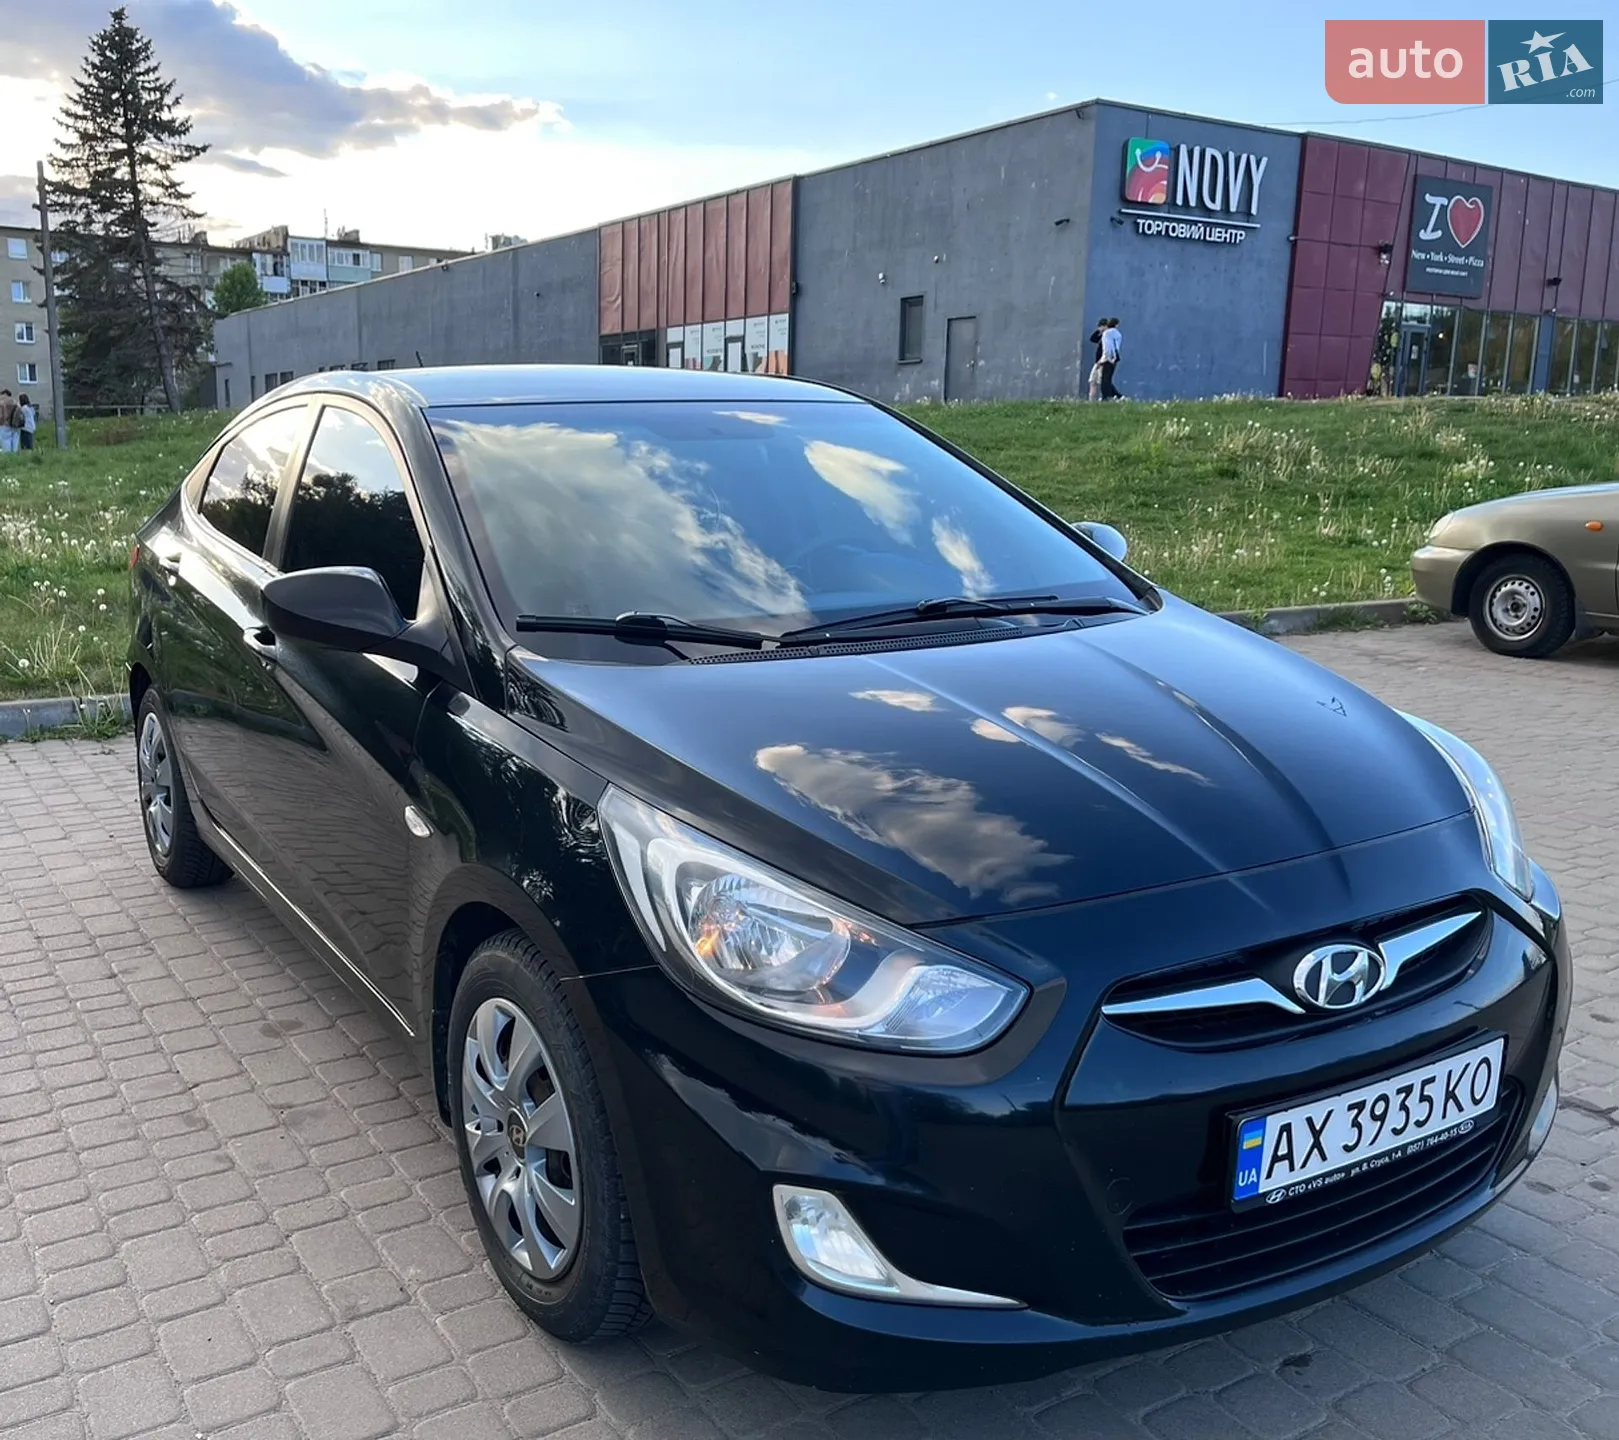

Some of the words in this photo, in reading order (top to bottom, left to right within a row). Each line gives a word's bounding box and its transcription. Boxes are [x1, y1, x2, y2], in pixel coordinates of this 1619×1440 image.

[1175, 143, 1268, 216] NOVY
[1137, 218, 1204, 240] ТОРГОВИЙ
[1205, 226, 1246, 244] ЦЕНТР
[1419, 193, 1449, 240] I
[1264, 1109, 1334, 1181] AX
[1342, 1074, 1437, 1153] 3935
[1441, 1056, 1492, 1121] KO
[1238, 1167, 1258, 1187] UA
